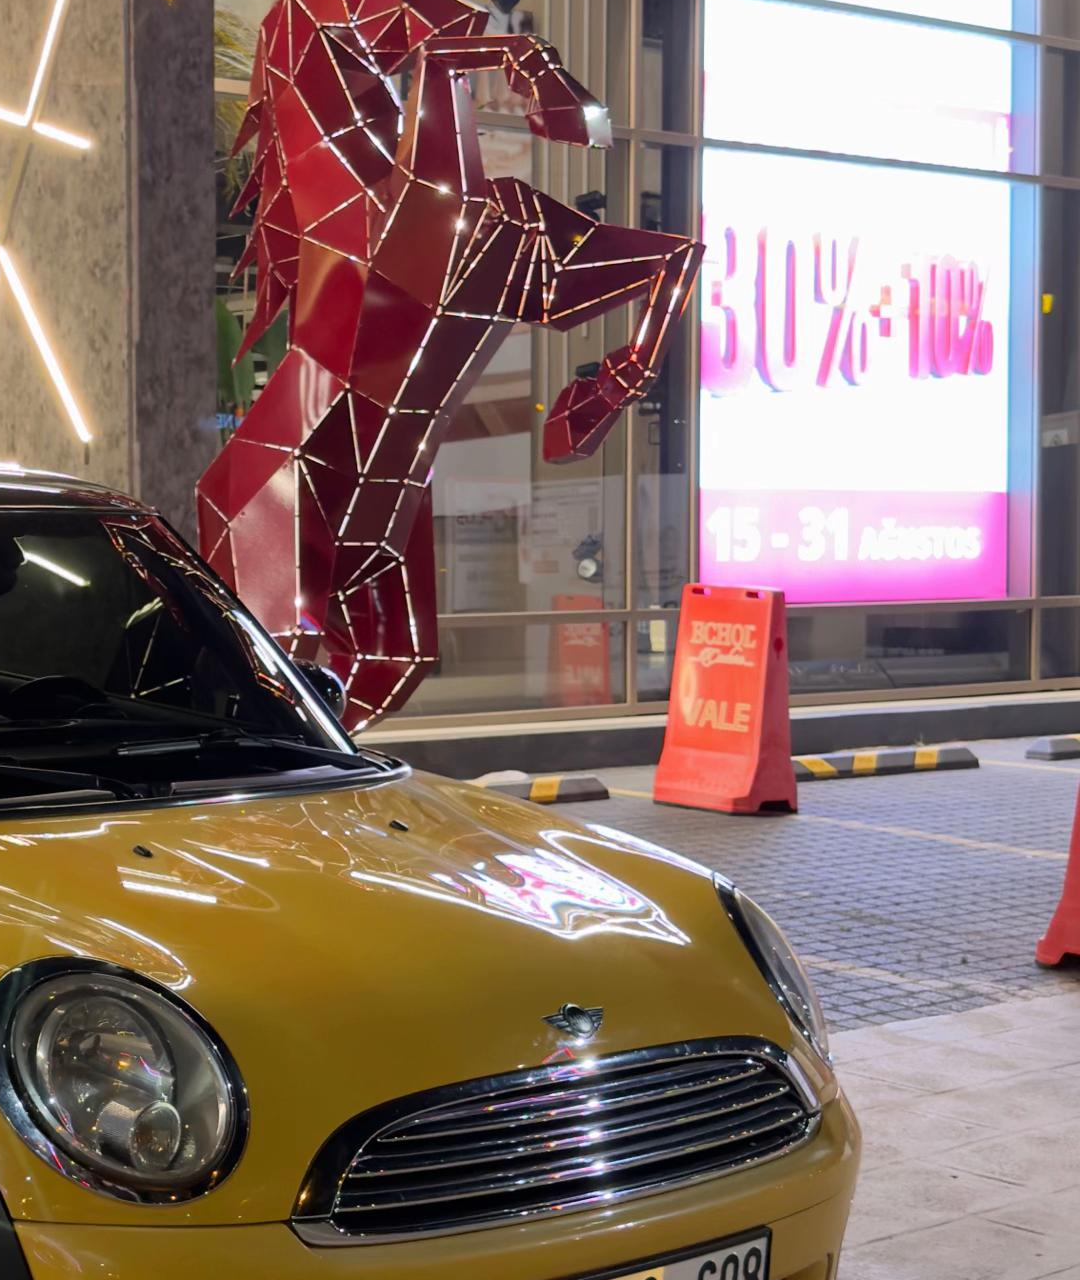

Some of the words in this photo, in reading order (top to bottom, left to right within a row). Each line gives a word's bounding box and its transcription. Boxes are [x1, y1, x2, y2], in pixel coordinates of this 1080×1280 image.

[706, 506, 762, 562] 15
[797, 506, 849, 562] 31
[682, 697, 752, 733] VALE
